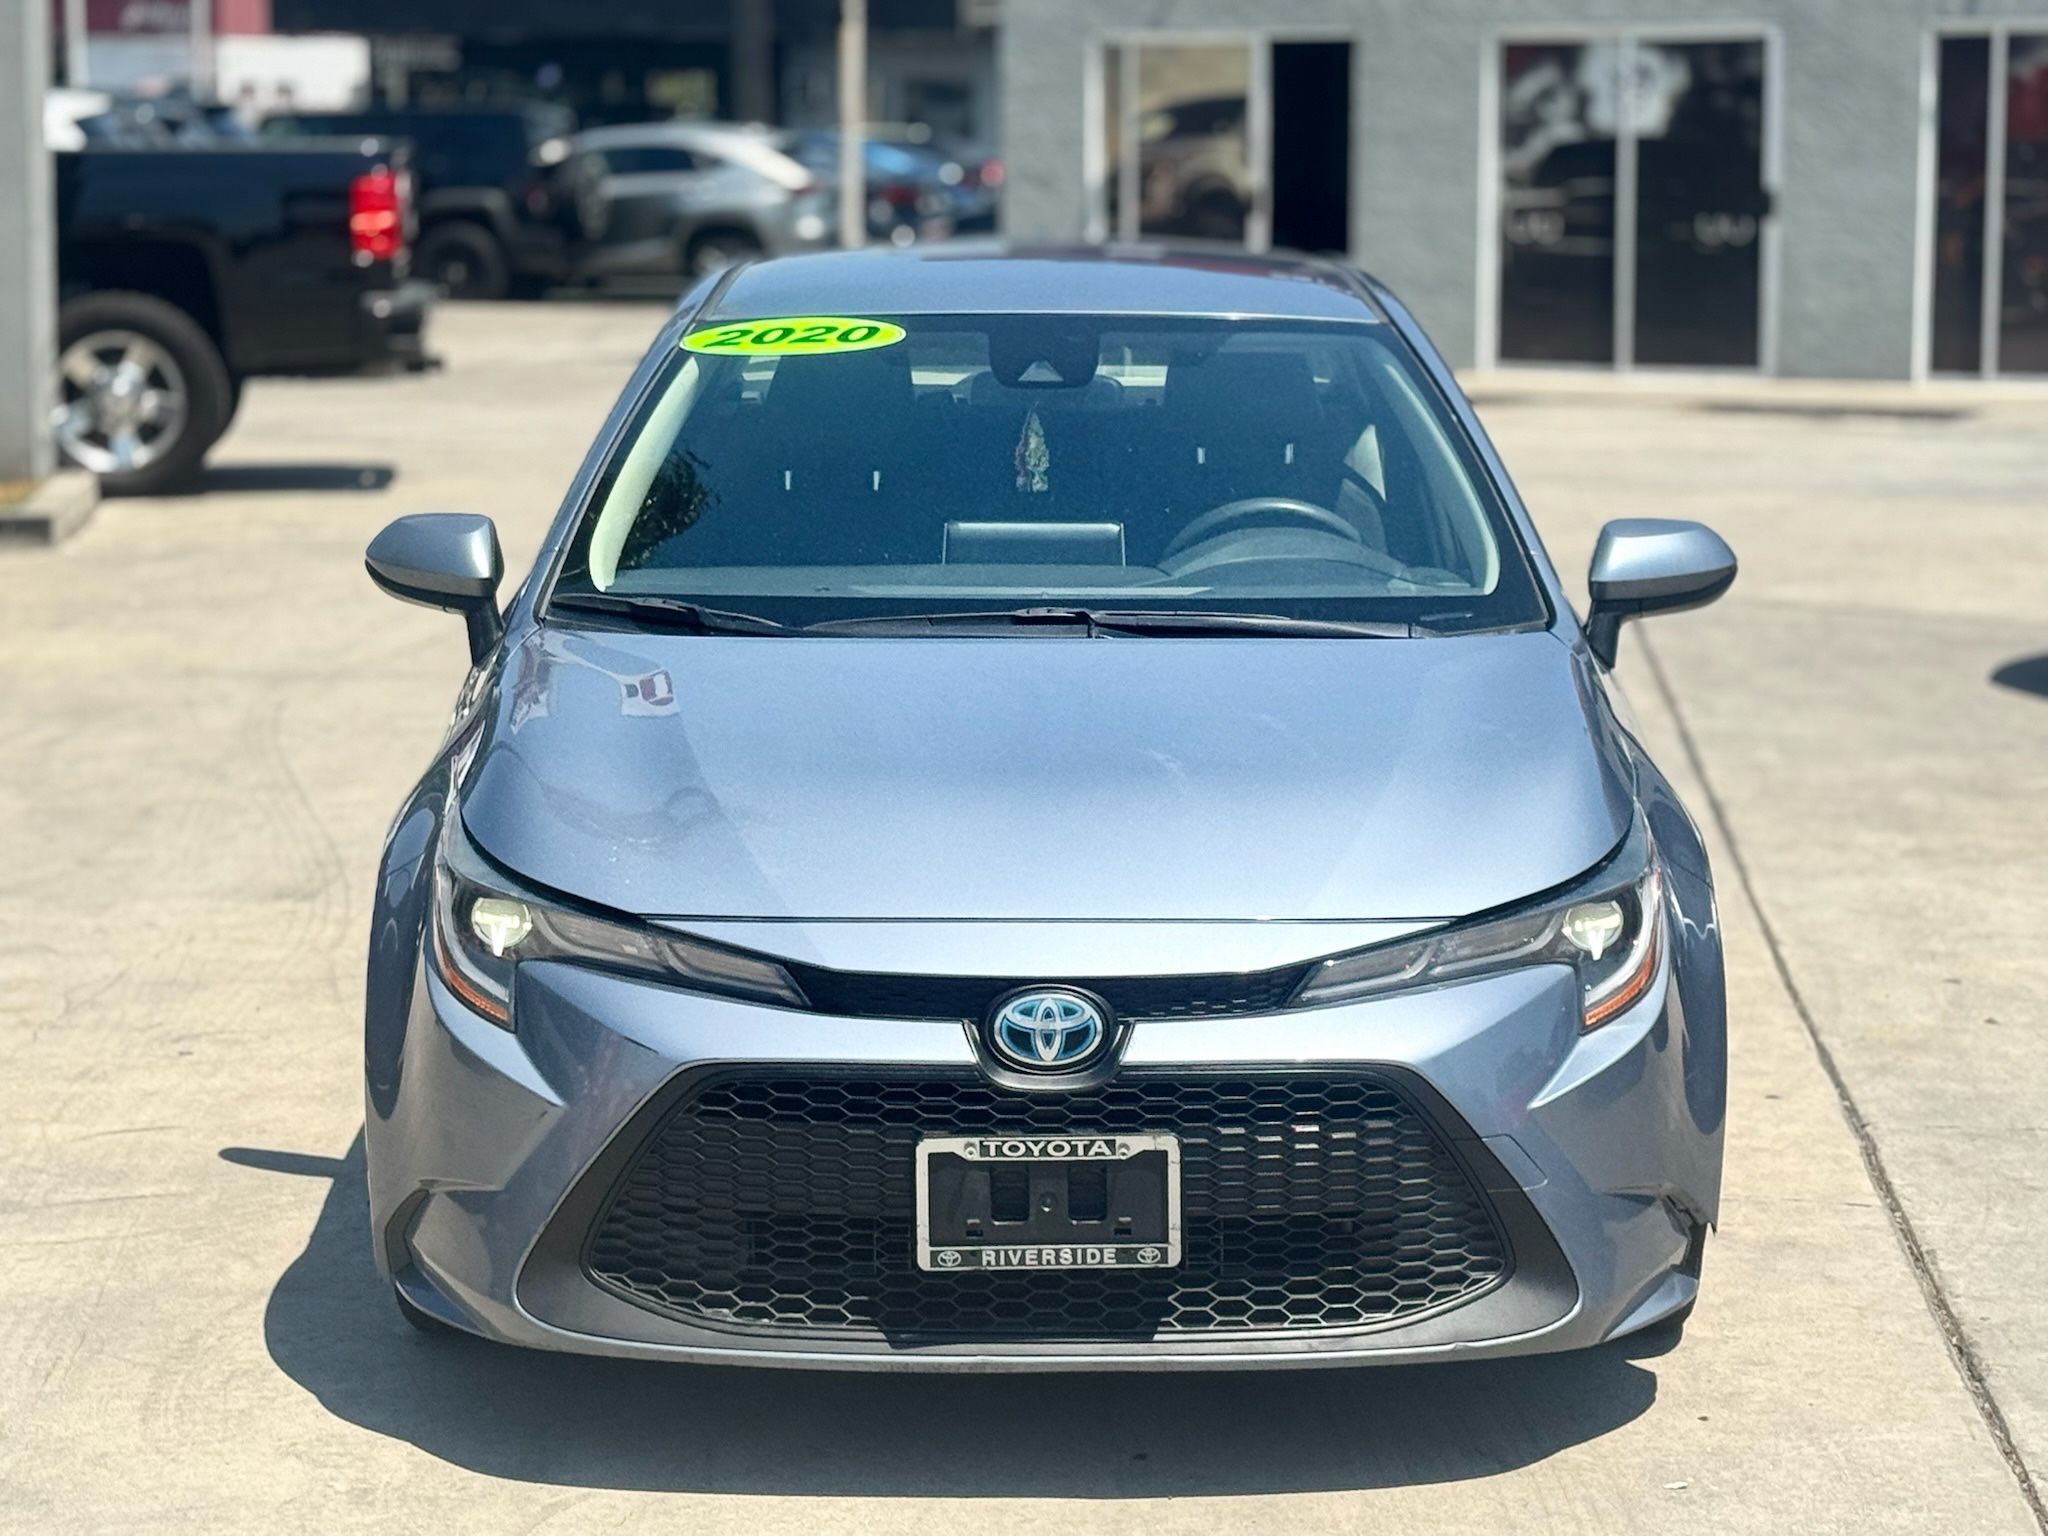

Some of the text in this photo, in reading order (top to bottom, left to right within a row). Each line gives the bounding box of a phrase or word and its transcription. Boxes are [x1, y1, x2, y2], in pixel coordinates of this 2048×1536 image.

[704, 326, 880, 347] 2020
[982, 1139, 1113, 1158] TOYOTA
[982, 1248, 1117, 1267] RIVERSIDE
